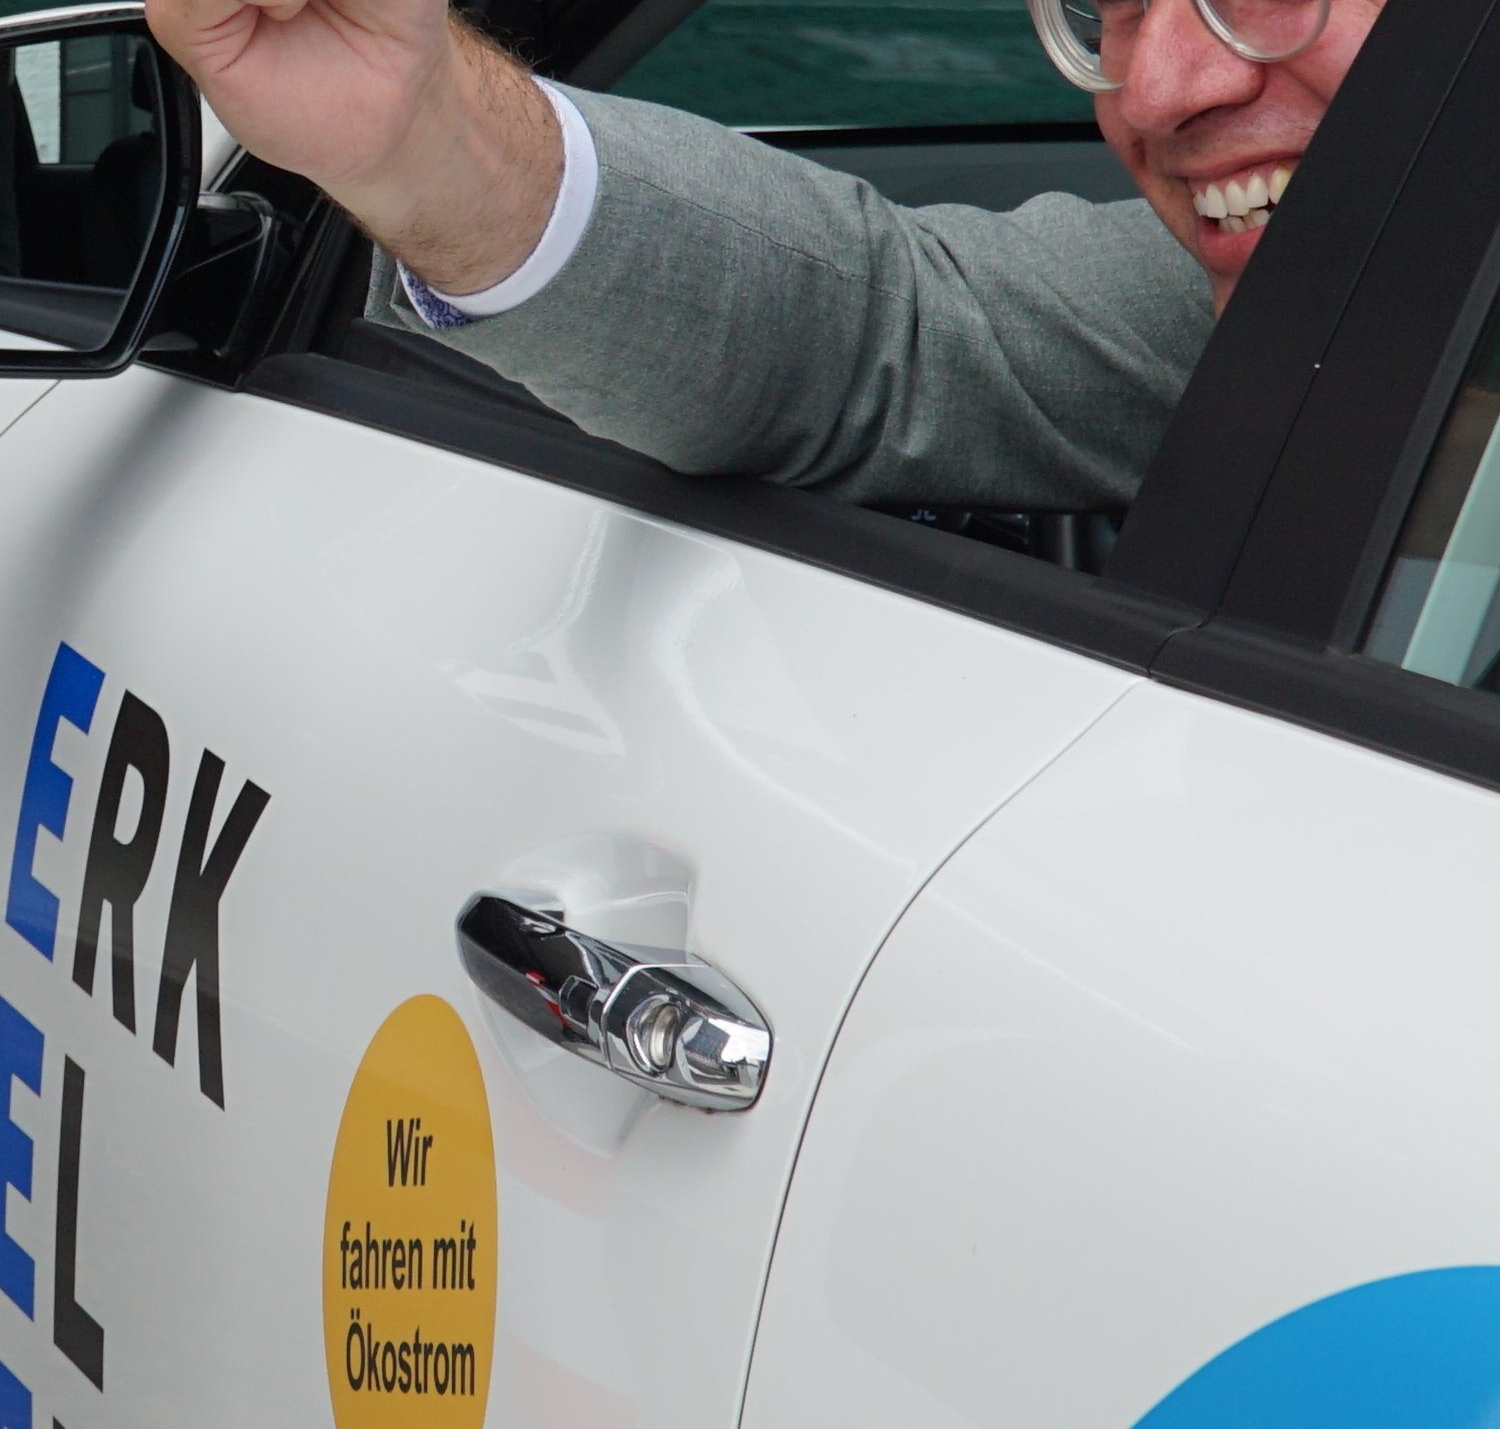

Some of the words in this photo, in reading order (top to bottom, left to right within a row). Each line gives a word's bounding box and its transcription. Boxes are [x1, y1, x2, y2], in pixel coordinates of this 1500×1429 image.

[5, 640, 272, 1110] ERK
[384, 1117, 434, 1188] Wir
[339, 1220, 424, 1291] fahren
[431, 1220, 477, 1291] mit
[345, 1308, 476, 1396] Ökostrom
